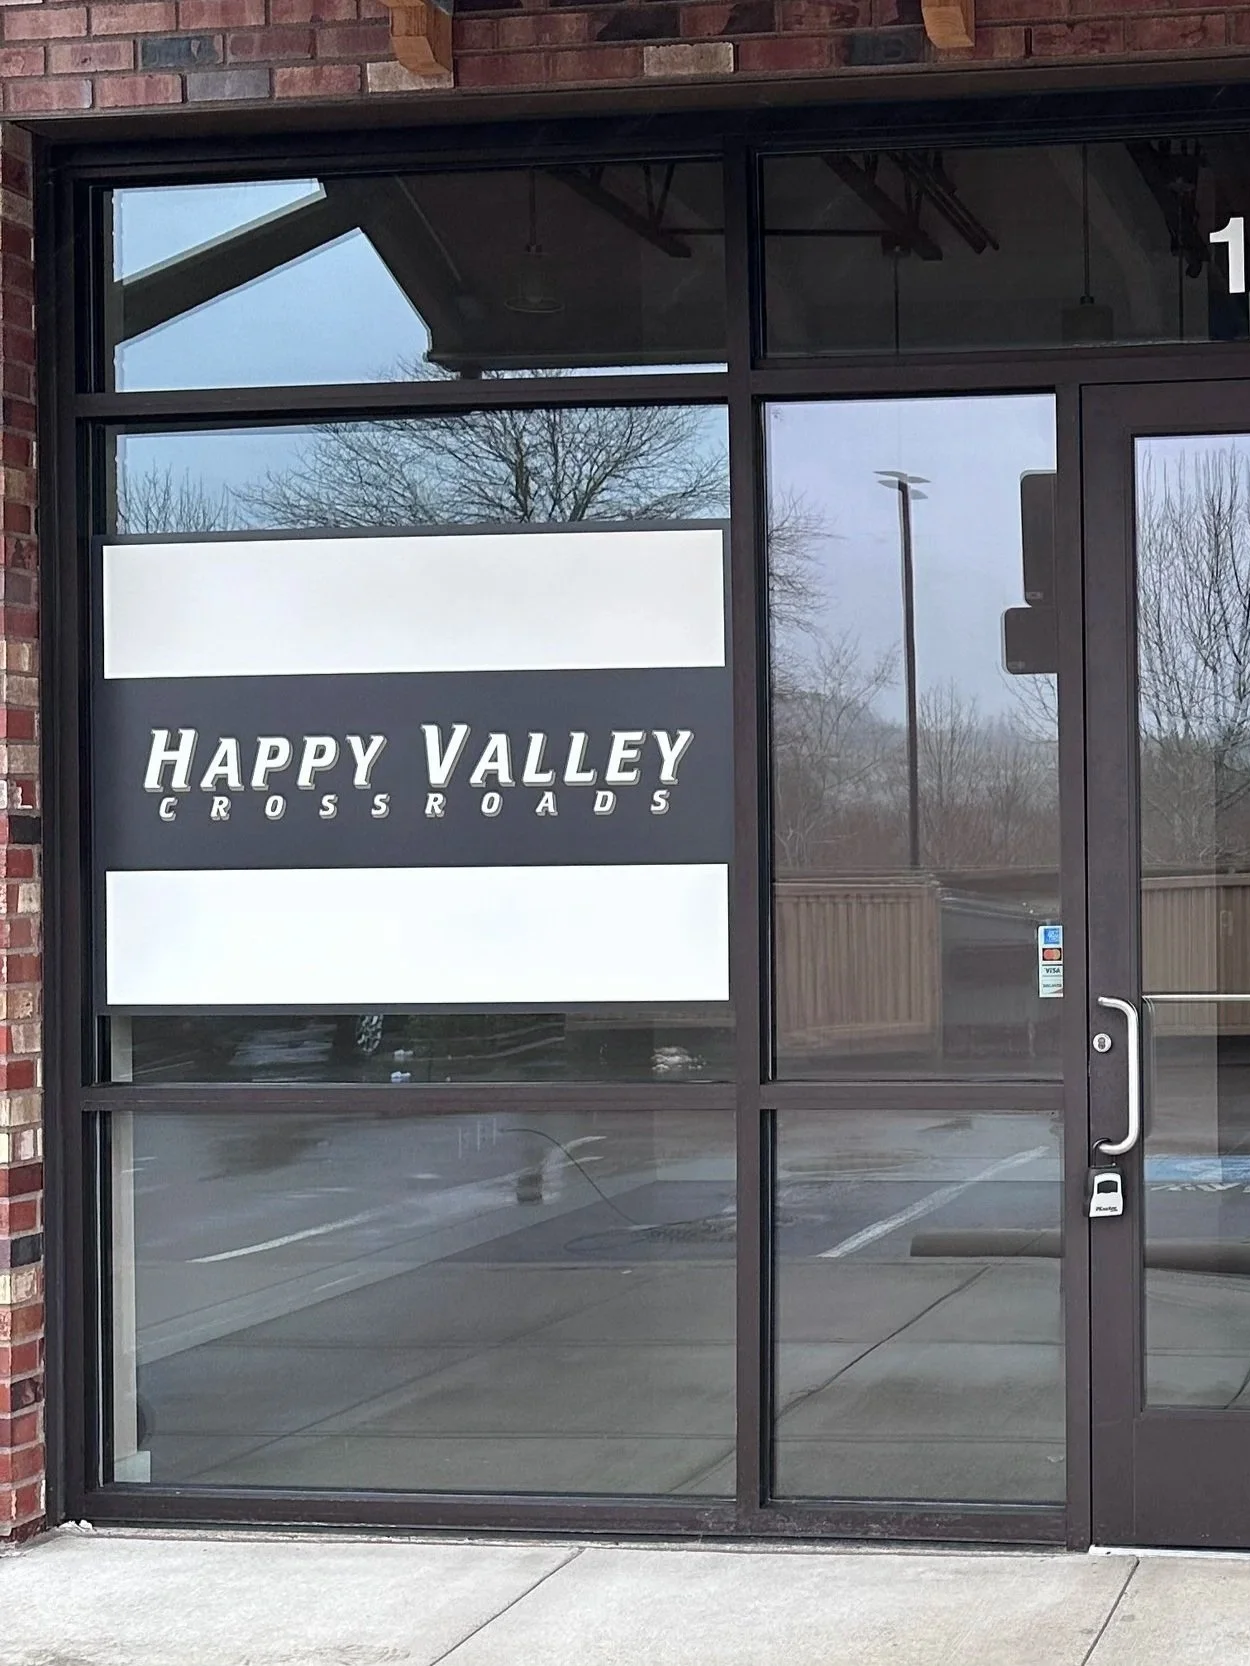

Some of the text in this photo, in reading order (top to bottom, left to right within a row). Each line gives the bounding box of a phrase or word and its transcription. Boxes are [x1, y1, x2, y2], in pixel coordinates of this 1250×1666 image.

[144, 723, 695, 793] HAPPY VALLEY
[158, 790, 671, 822] CROSSROADS
